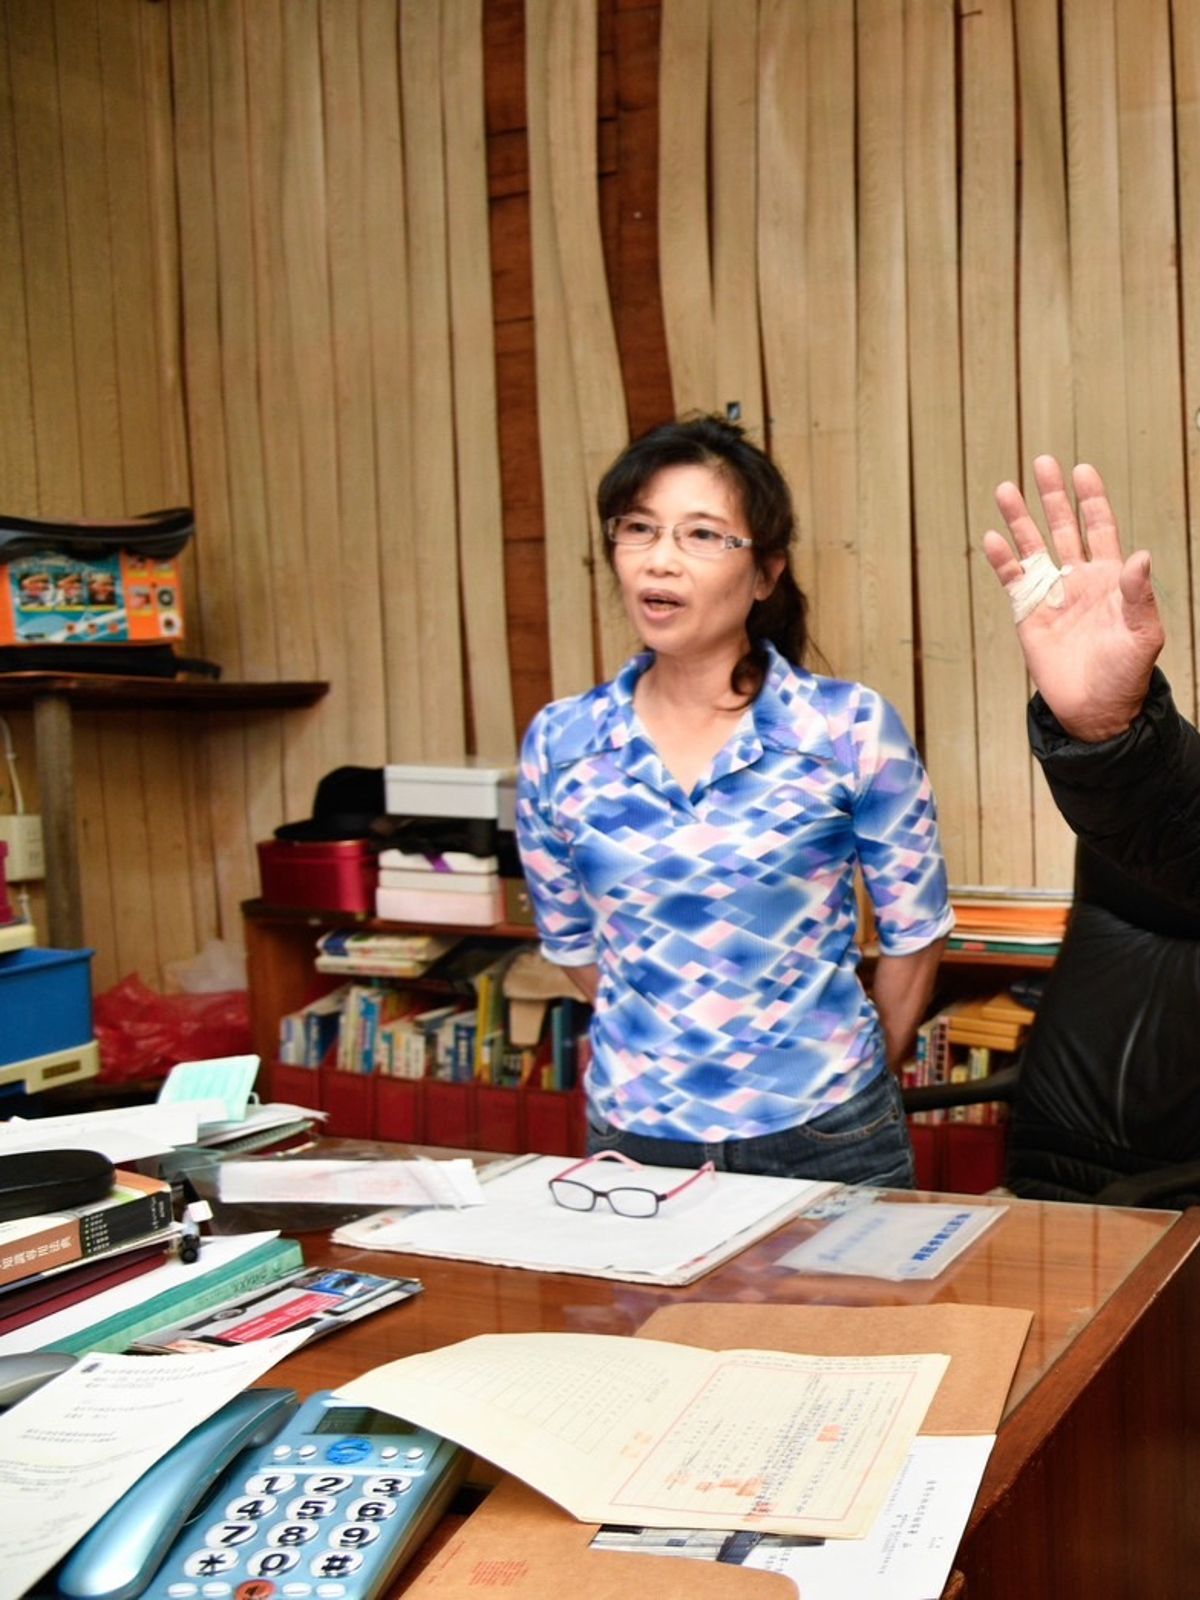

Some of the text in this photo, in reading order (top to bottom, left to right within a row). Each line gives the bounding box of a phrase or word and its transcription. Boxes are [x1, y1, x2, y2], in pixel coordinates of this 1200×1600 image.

[260, 1475, 402, 1493] 1 2 3
[236, 1500, 386, 1518] 4 5 6
[220, 1525, 369, 1544] 7 8 9
[259, 1553, 290, 1572] 0
